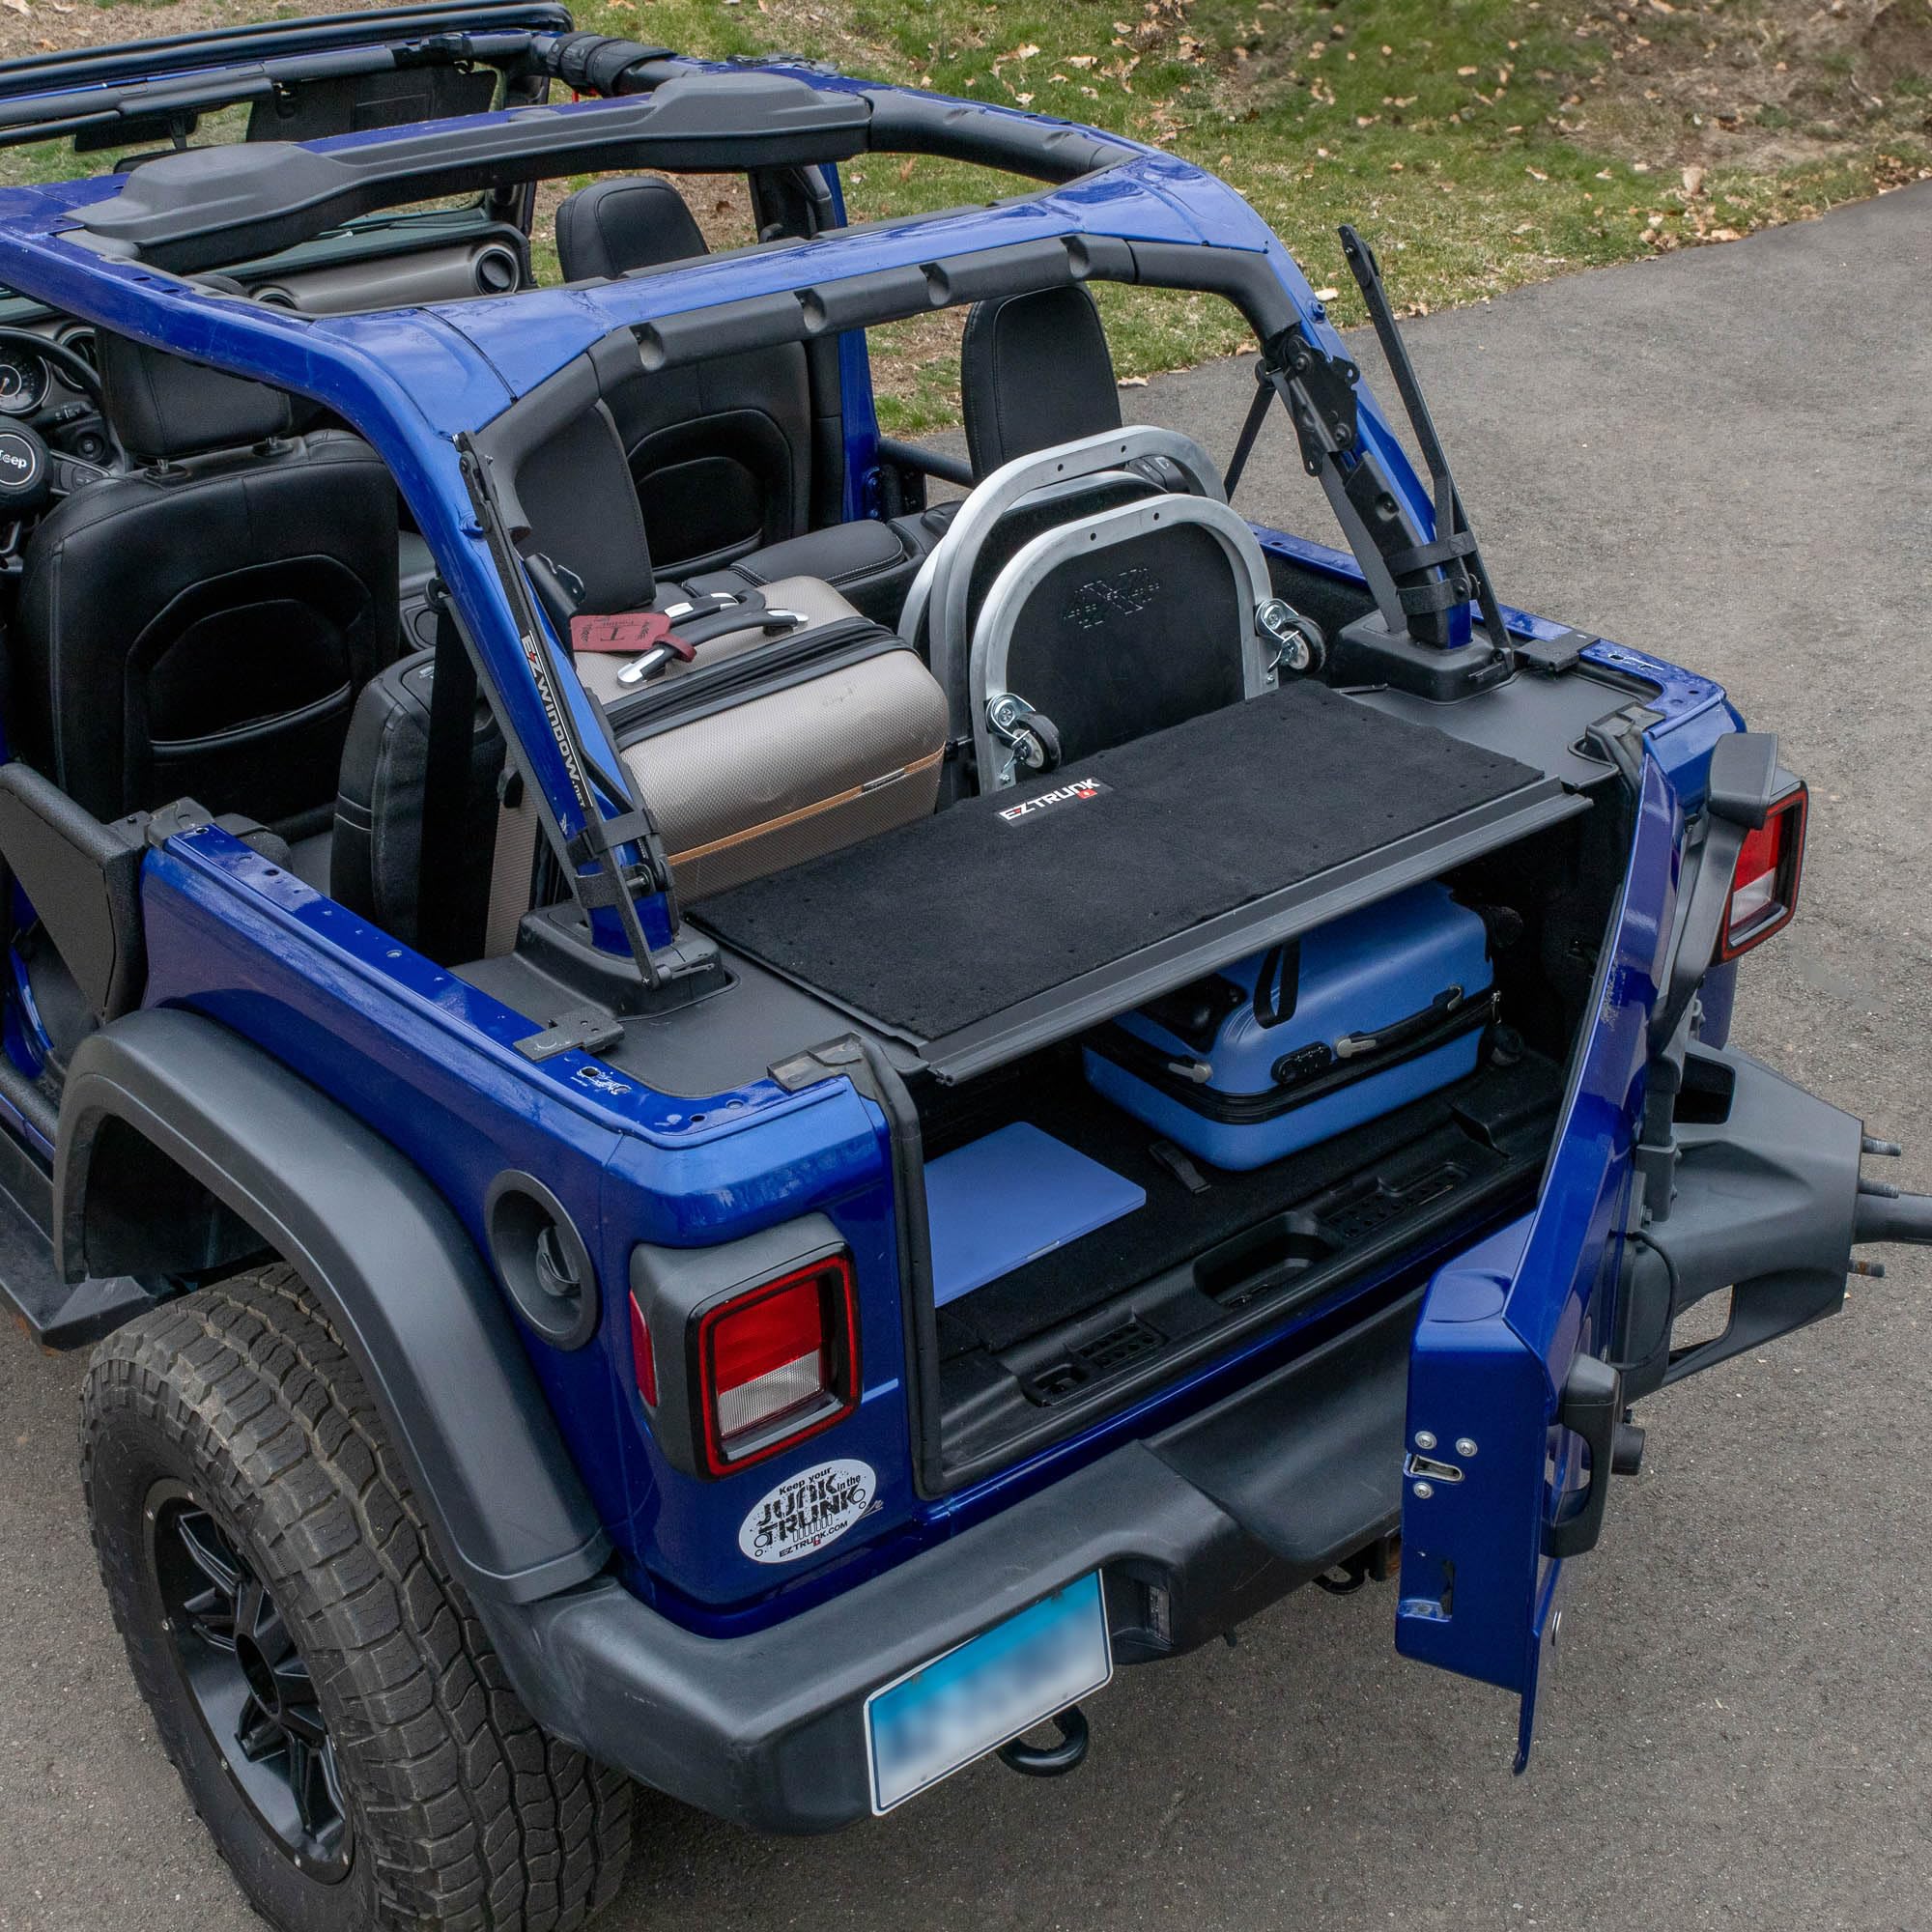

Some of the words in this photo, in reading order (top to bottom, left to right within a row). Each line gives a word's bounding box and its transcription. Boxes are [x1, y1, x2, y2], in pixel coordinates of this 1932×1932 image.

[998, 778, 1101, 821] EZTRUNK
[756, 1473, 838, 1526] JUNK
[779, 1479, 806, 1495] Keep
[808, 1466, 833, 1484] your
[837, 1483, 846, 1492] in
[846, 1475, 862, 1488] the
[757, 1484, 859, 1547] TRUNK
